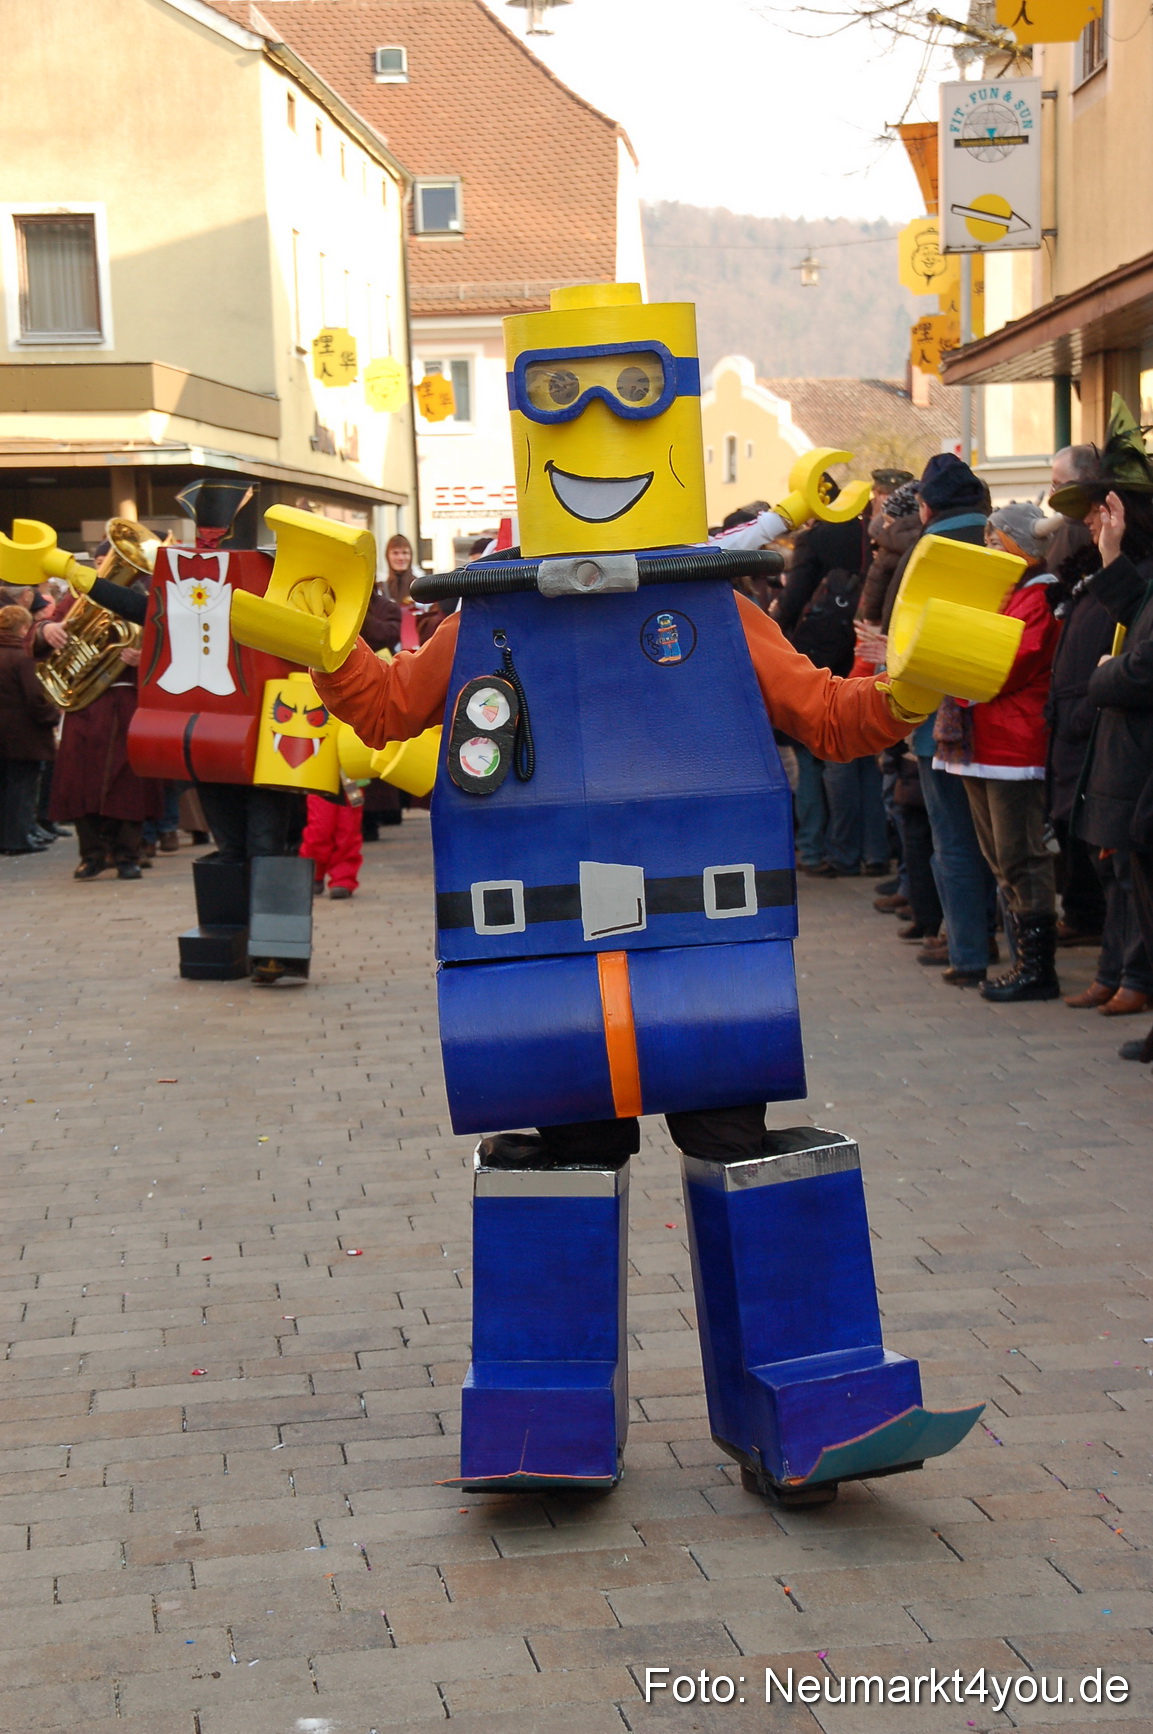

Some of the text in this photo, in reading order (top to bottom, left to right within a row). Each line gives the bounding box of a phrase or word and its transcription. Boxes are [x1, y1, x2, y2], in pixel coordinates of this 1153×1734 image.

[949, 107, 967, 133] FIT
[969, 88, 999, 104] FUN
[1002, 91, 1012, 103] &
[1014, 101, 1034, 129] SUN
